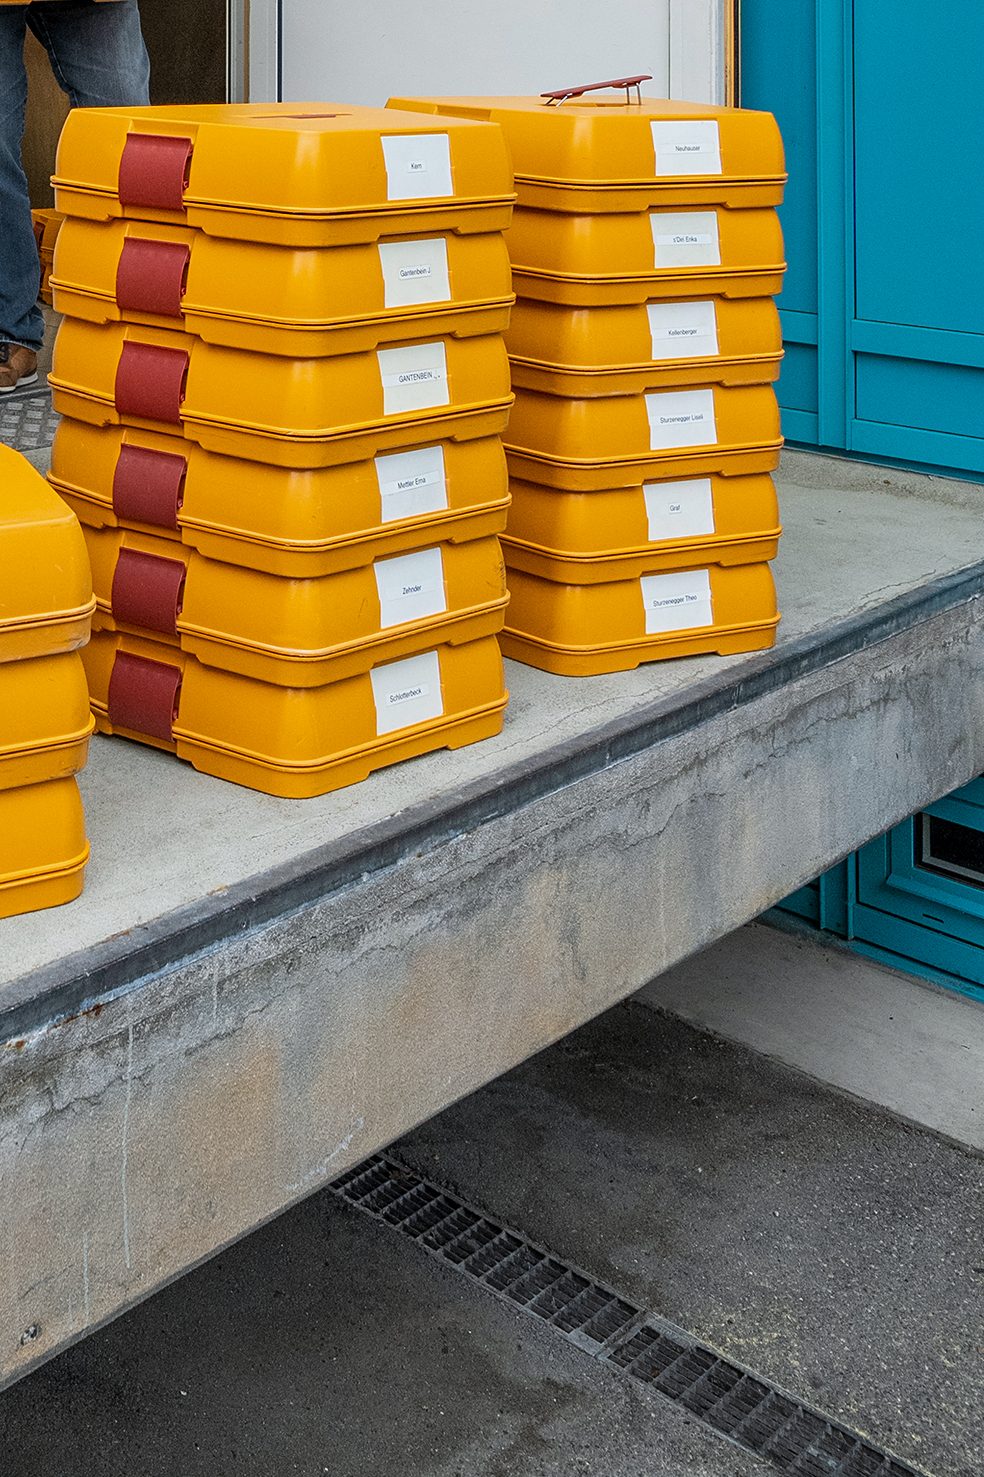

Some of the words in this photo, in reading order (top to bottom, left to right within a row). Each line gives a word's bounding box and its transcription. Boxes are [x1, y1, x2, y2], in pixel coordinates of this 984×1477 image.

[399, 267, 427, 277] Gantenbein
[398, 371, 433, 383] GANTENBEIN
[659, 415, 691, 424] Sturzenegger
[397, 480, 415, 489] Mettler
[669, 504, 681, 512] Graf
[402, 585, 422, 595] Zehnder
[653, 597, 685, 607] Sturzenegger
[685, 594, 698, 602] Theo
[389, 687, 422, 703] Schlotterbeck
